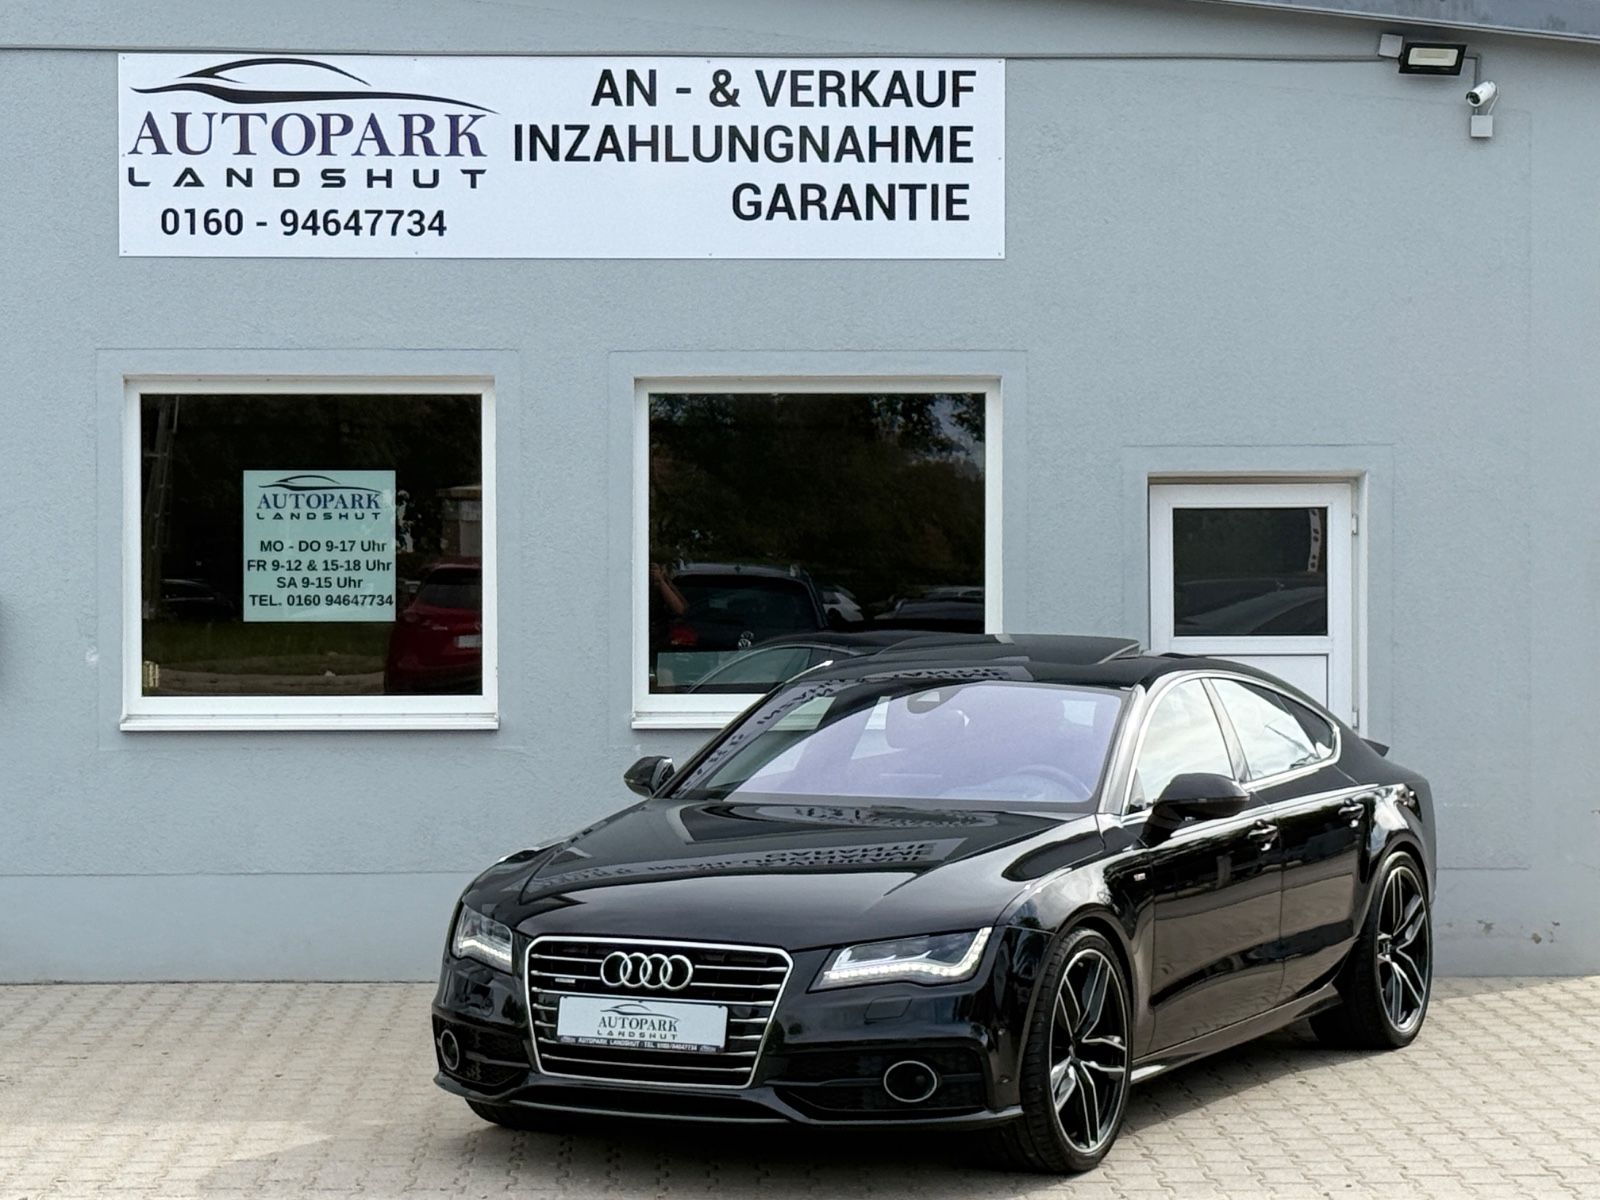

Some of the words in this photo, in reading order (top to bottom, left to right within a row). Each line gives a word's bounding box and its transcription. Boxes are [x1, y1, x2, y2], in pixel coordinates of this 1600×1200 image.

[590, 68, 657, 107] AN
[708, 68, 741, 108] &
[754, 69, 977, 108] VERKAUF
[127, 110, 488, 158] AUTOPARK
[513, 123, 975, 164] INZAHLUNGNAHME
[127, 166, 488, 189] LANDSHUT
[731, 182, 970, 222] GARANTIE
[160, 207, 244, 236] 0160
[279, 208, 447, 237] 94647734
[257, 493, 381, 509] AUTOPARK
[256, 512, 381, 520] LANDSHUT
[259, 540, 285, 552] MO
[298, 540, 321, 552] DO
[325, 540, 356, 552] 9-17
[360, 540, 387, 552] Uhr
[247, 559, 267, 572] FR
[271, 559, 302, 572] 9-12
[306, 559, 318, 572] &
[322, 559, 362, 572] 15-18
[365, 559, 393, 572] Uhr
[276, 576, 298, 589] SA
[301, 576, 333, 589] 9-15
[336, 576, 364, 589] Uhr
[248, 594, 283, 606] TEL.
[286, 594, 321, 607] 0160
[325, 594, 394, 607] 94647734
[598, 1016, 679, 1033] AUTOPARK
[597, 1030, 678, 1041] LANDSHUT
